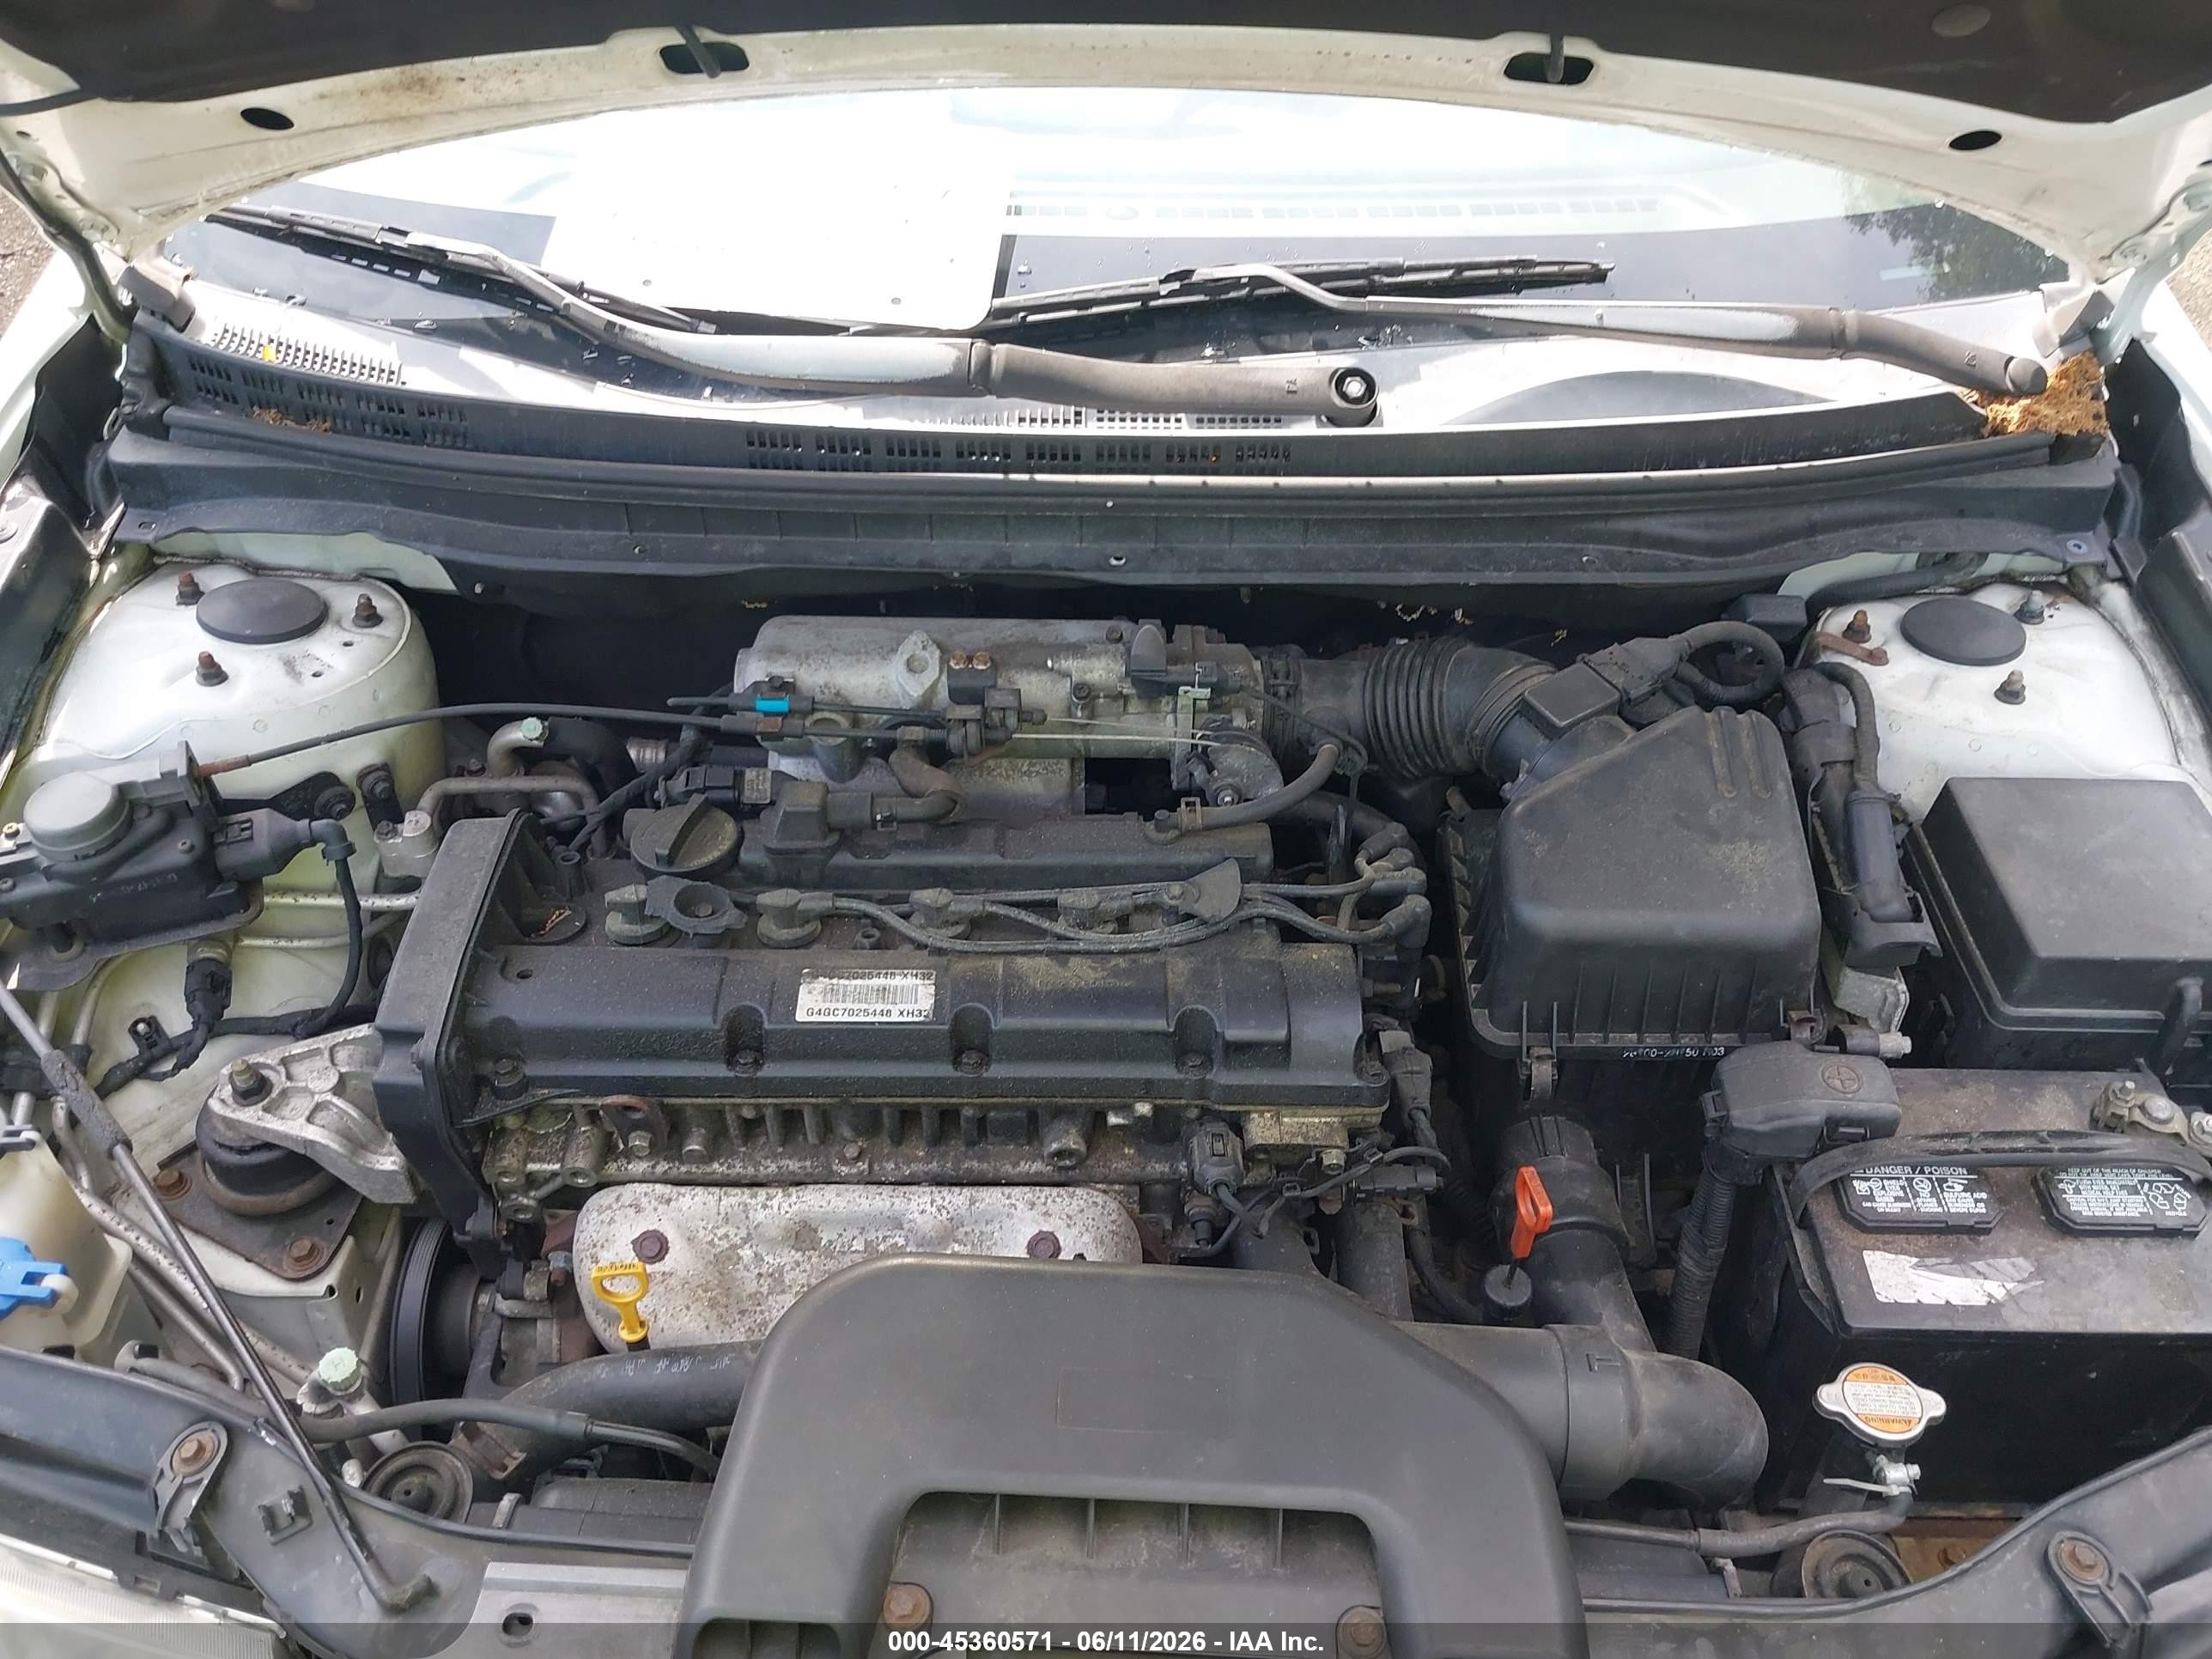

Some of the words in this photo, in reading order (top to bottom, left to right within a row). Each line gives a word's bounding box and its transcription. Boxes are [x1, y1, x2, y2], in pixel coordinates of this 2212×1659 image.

[805, 1007, 892, 1018] G4GC7025448
[1865, 1165, 1912, 1175] DANGER
[1915, 1166, 1921, 1175] /
[1923, 1166, 1968, 1176] POISON
